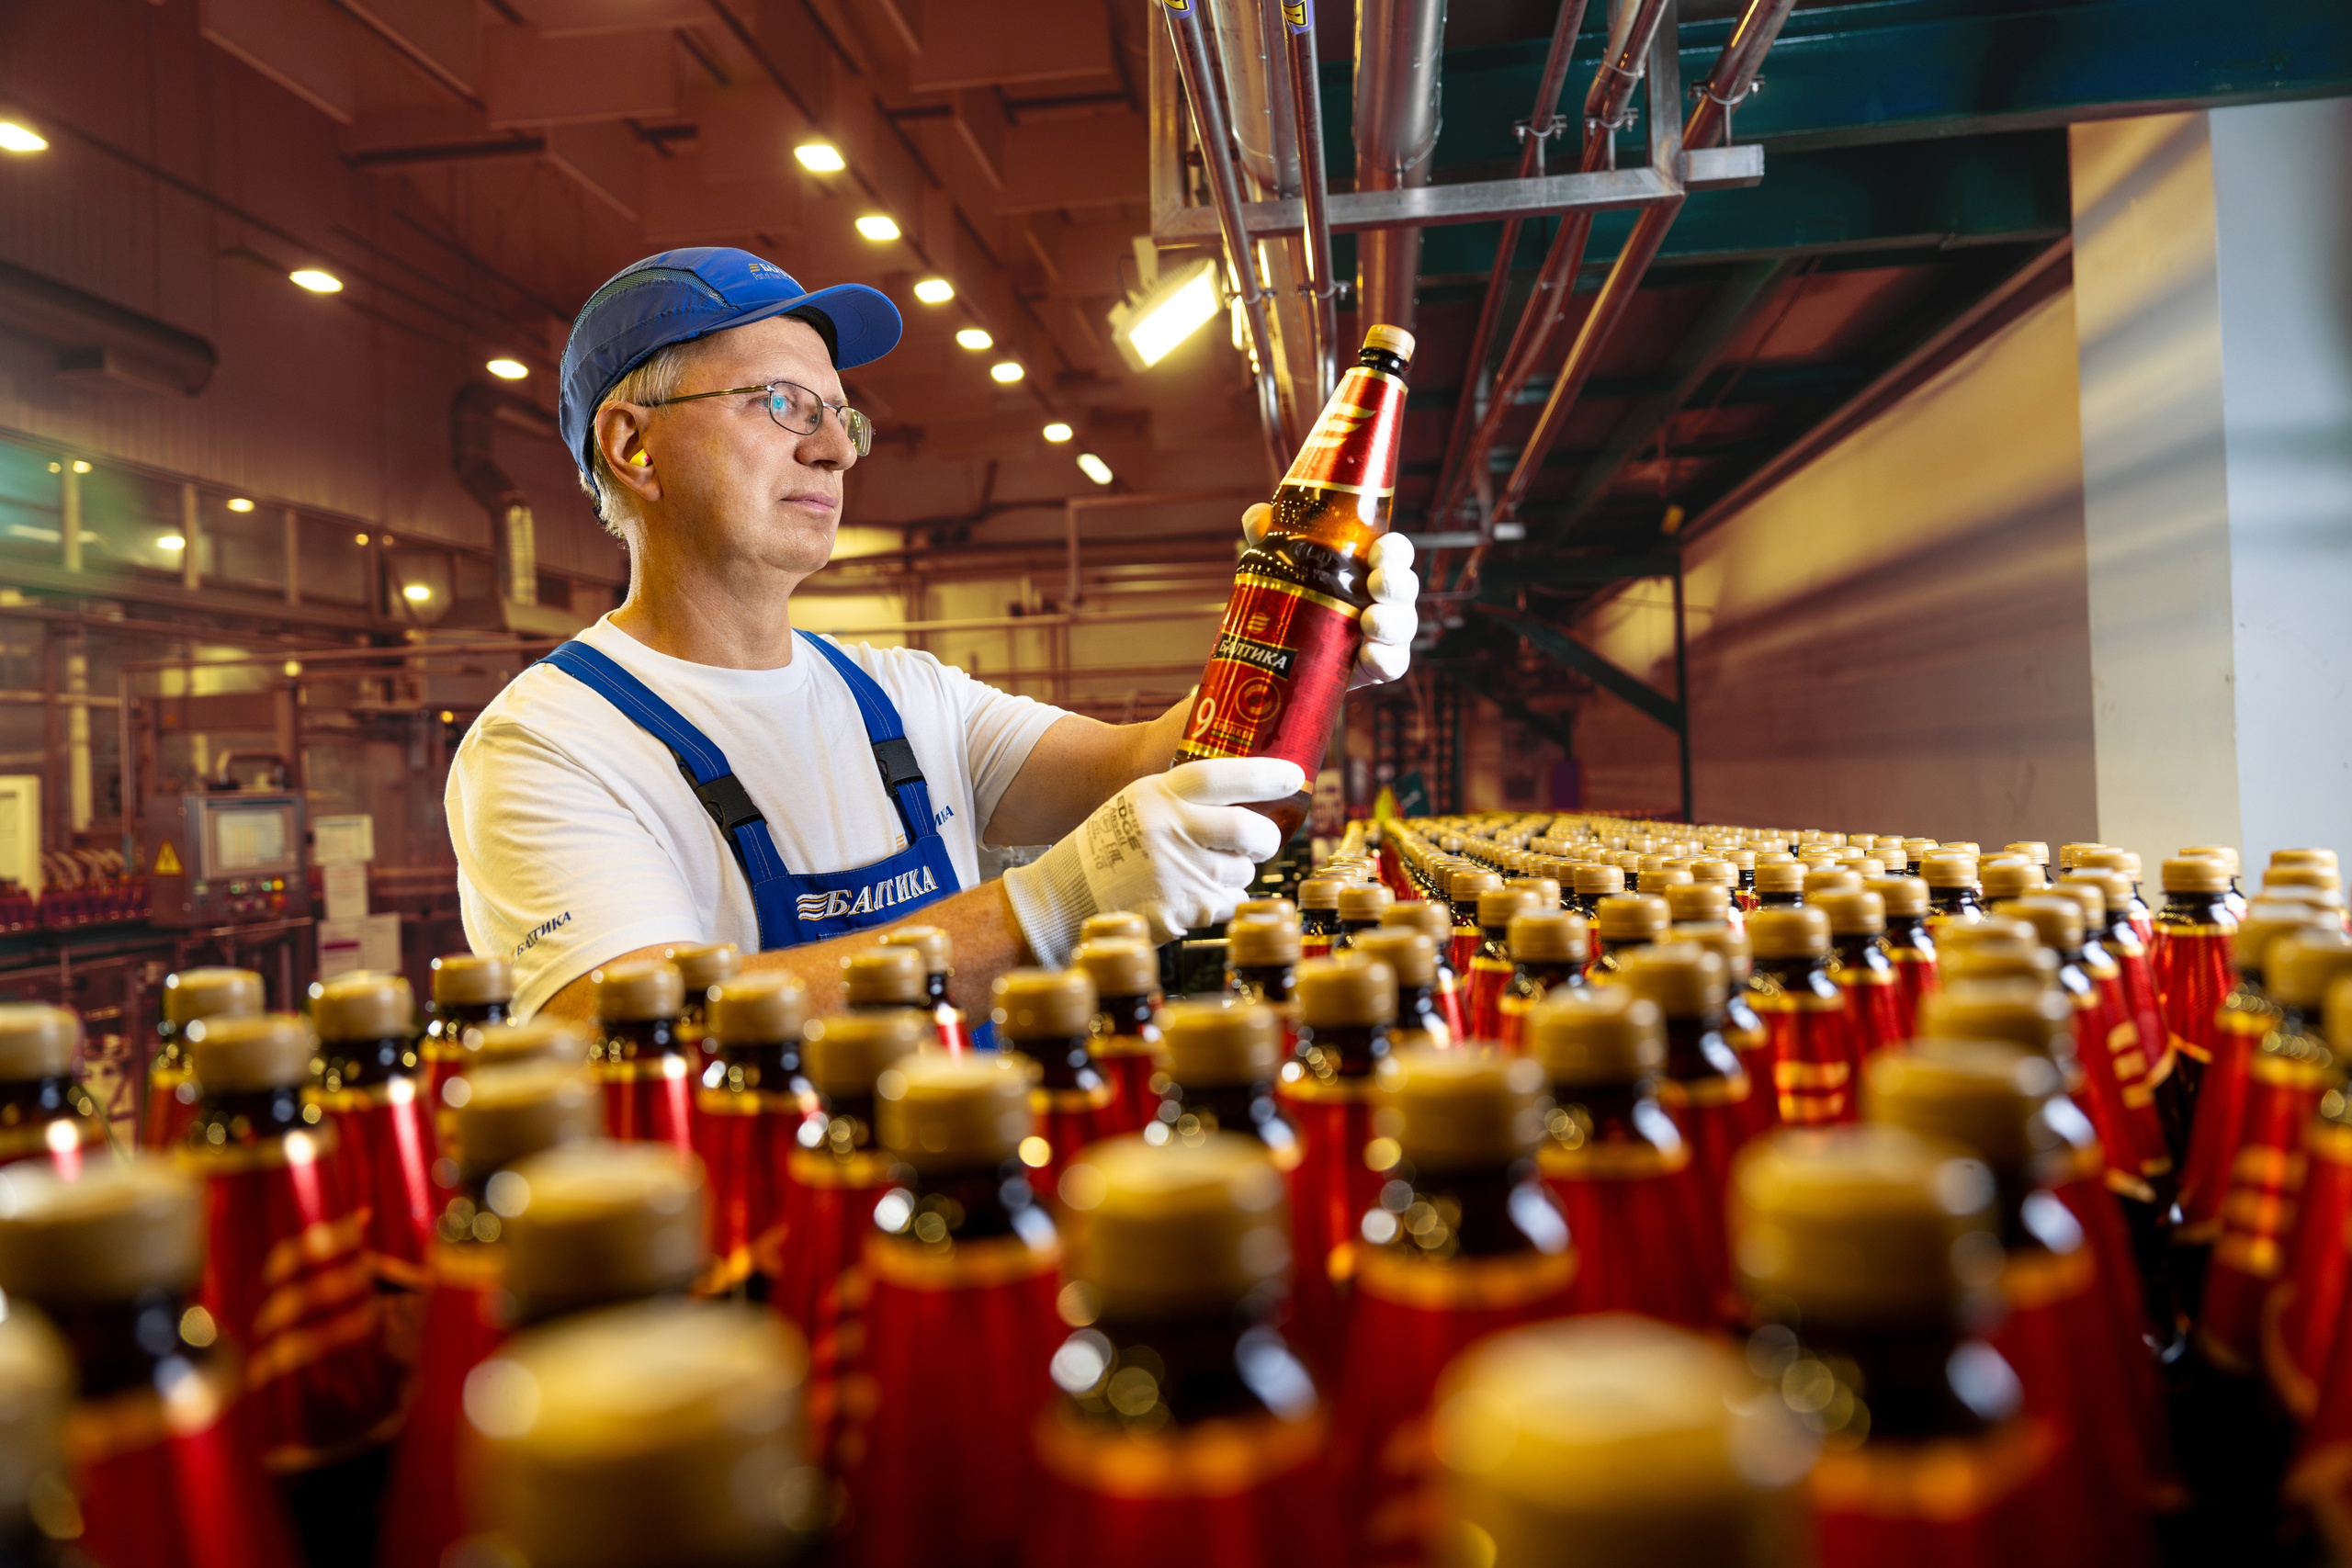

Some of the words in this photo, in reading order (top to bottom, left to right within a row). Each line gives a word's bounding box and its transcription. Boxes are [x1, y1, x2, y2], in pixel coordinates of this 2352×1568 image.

[1218, 639, 1287, 670] БАЛТИКА
[1193, 697, 1216, 738] 9
[1110, 807, 1128, 848] Ansell
[1117, 795, 1142, 851] EDGE
[824, 865, 939, 918] БАЛТИКА
[516, 910, 572, 956] БАЛТИКА
